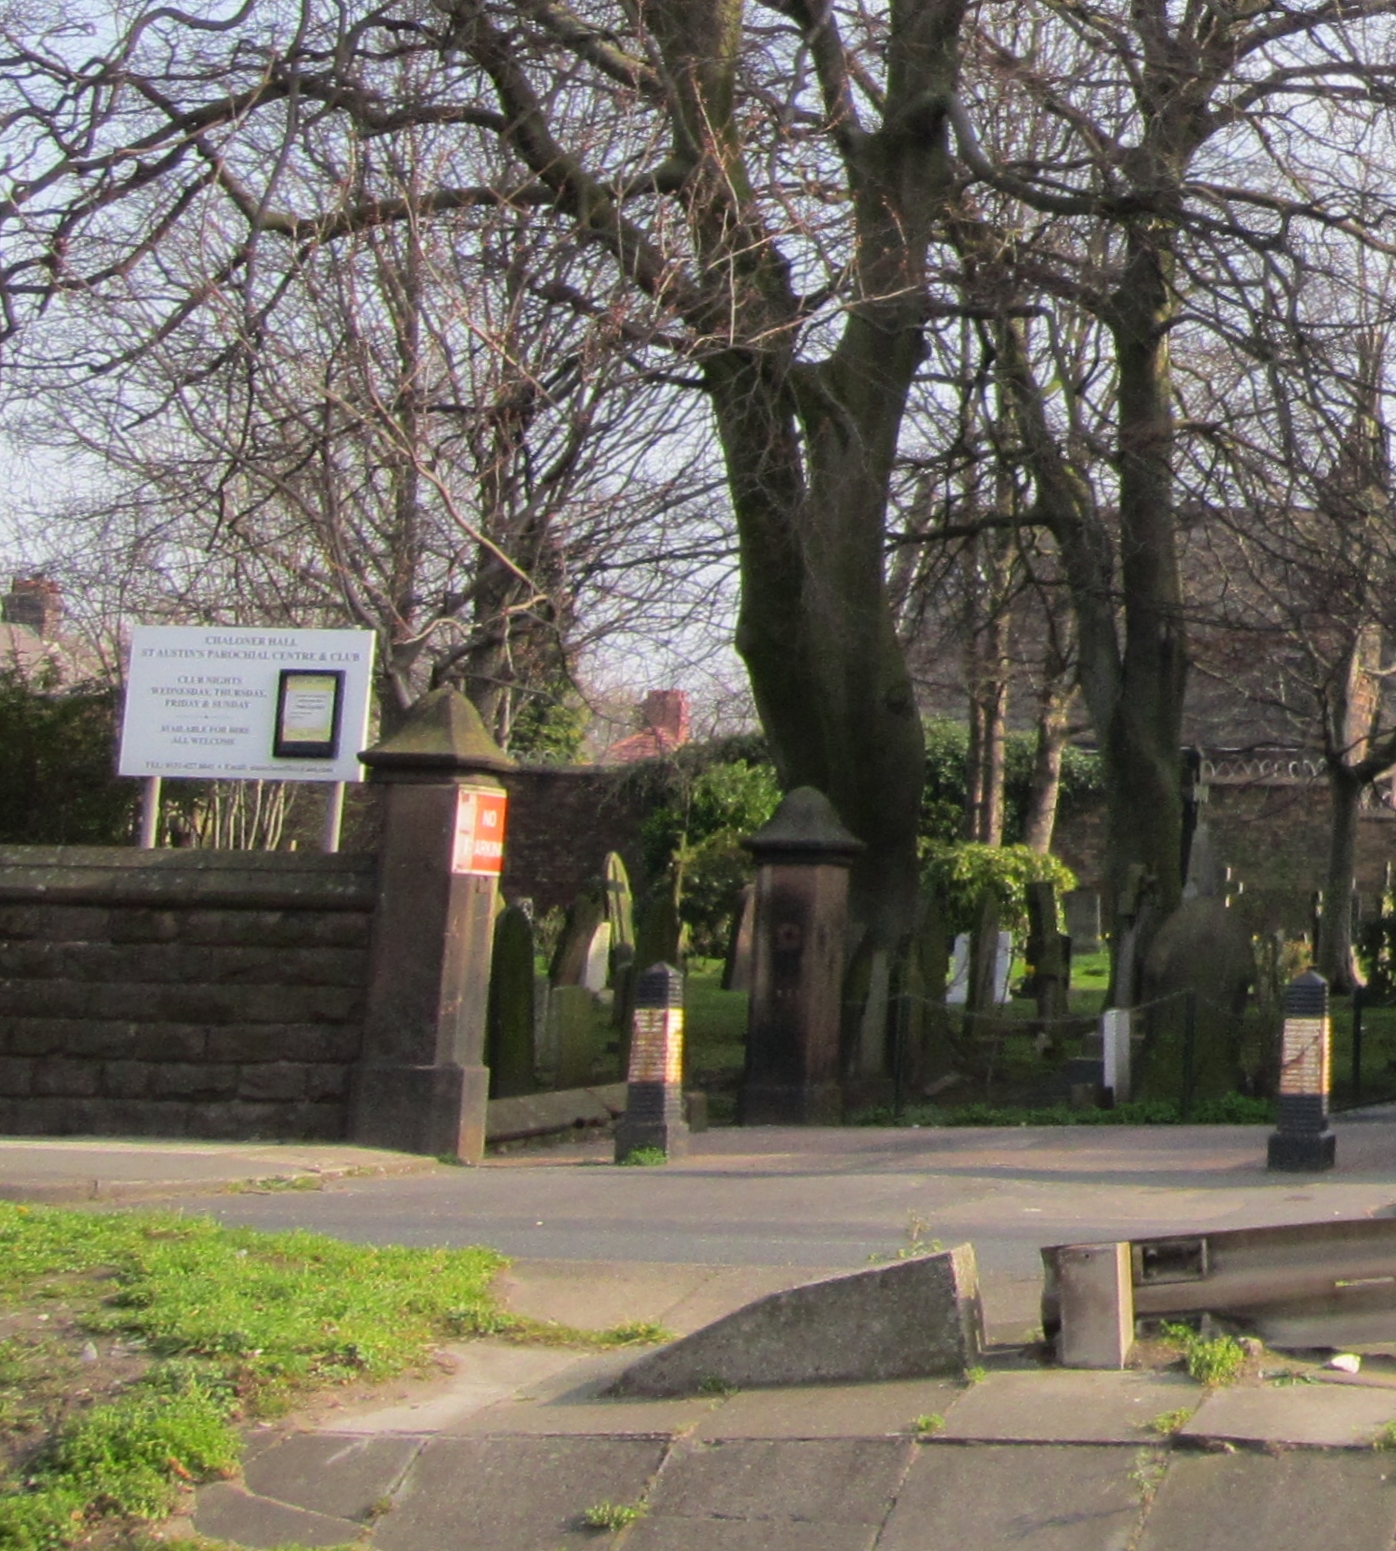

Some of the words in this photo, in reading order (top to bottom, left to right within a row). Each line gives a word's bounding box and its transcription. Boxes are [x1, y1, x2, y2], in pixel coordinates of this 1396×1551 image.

[205, 636, 266, 646] CHALONER
[268, 637, 298, 647] HALL
[141, 648, 155, 658] ST
[207, 650, 270, 660] PAROCHIAL
[272, 651, 318, 661] CENTRE
[319, 652, 327, 662] &
[330, 652, 361, 662] CLUB
[481, 809, 498, 828] NO
[463, 837, 503, 858] PARKIN
